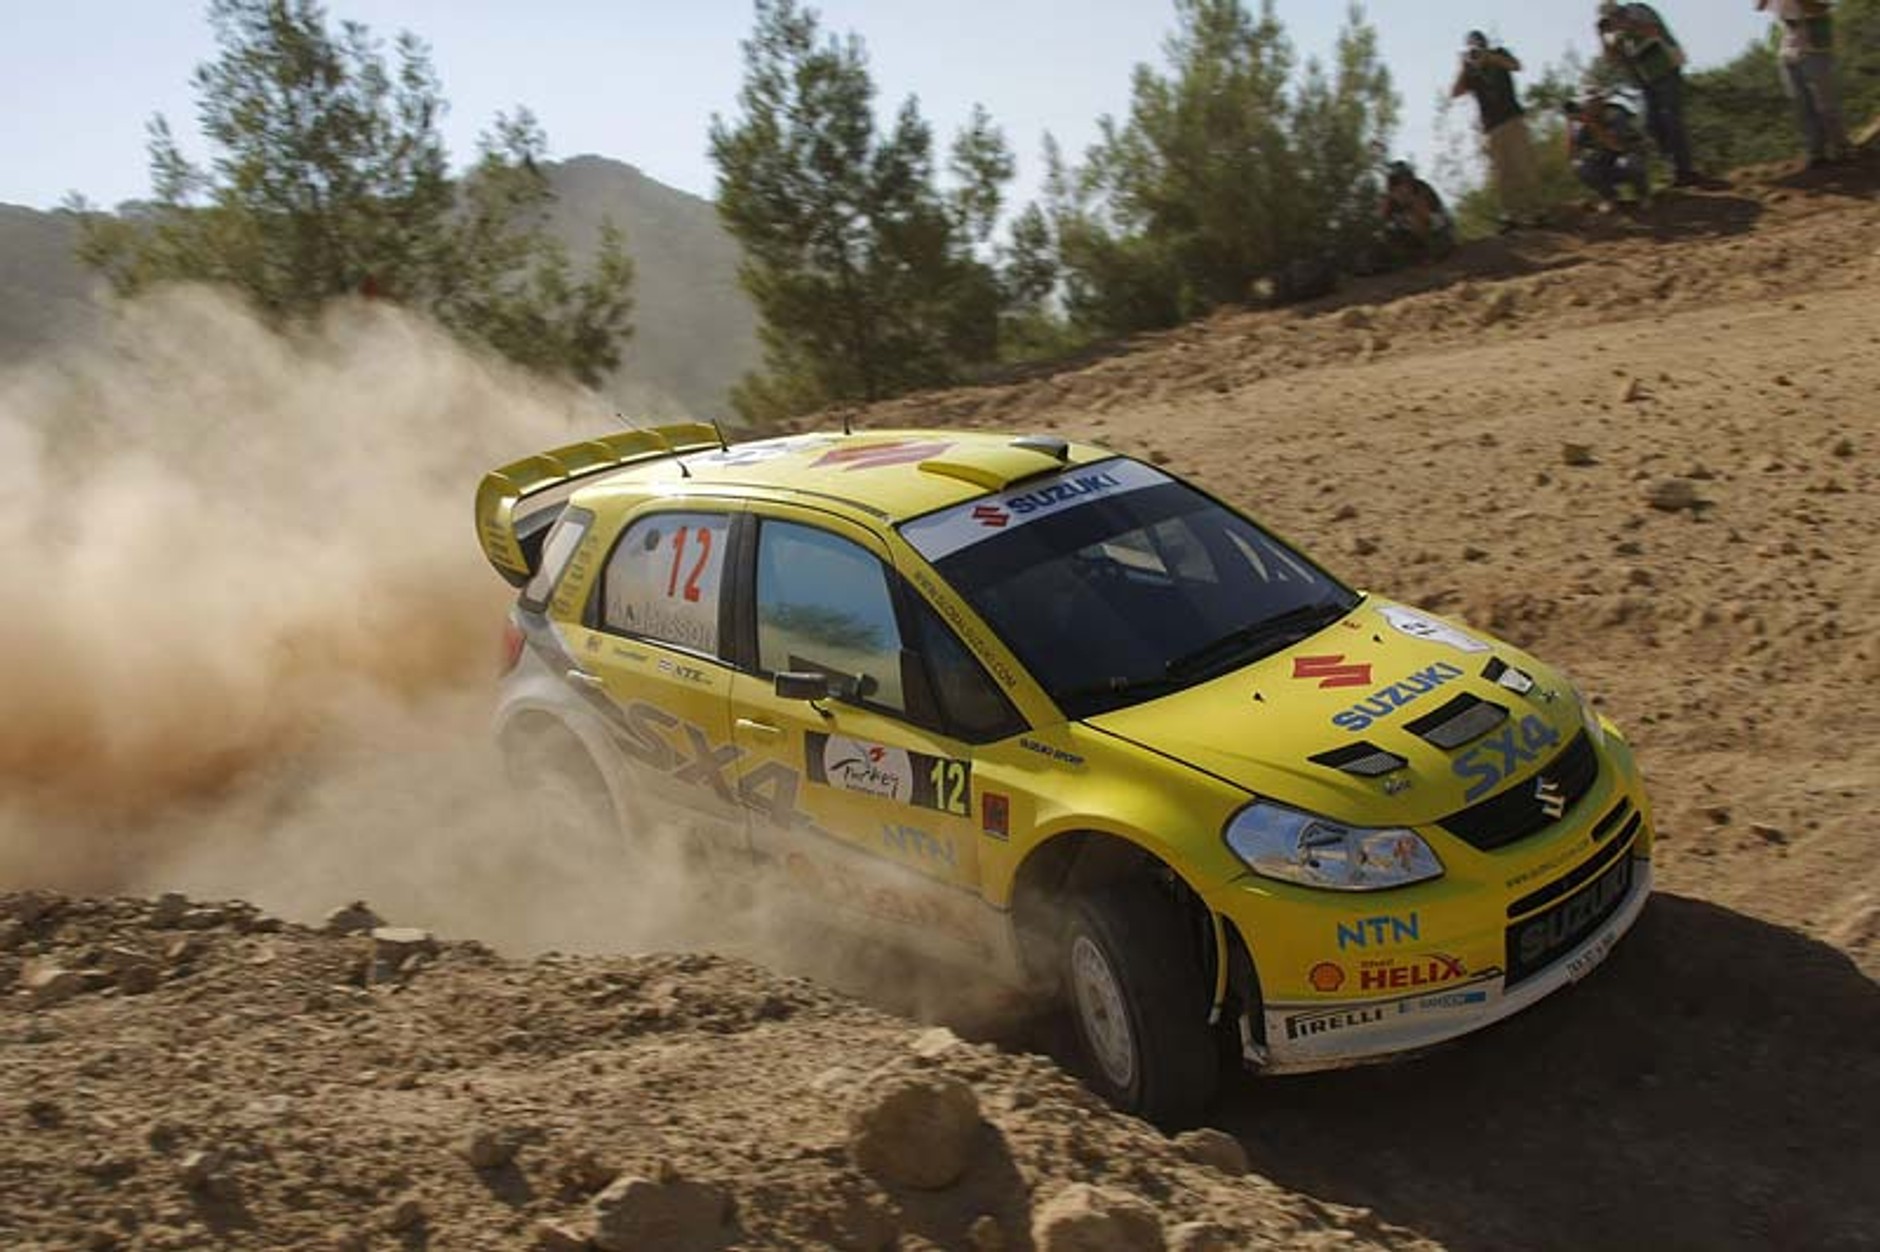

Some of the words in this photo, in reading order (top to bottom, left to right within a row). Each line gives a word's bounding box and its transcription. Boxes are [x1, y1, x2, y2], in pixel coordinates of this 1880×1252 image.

[1007, 473, 1121, 514] SUZUKI
[668, 526, 712, 602] 12
[1332, 662, 1464, 732] SUZUKI
[613, 702, 800, 832] SX4
[1453, 714, 1560, 801] SX4
[844, 766, 899, 799] Turkey
[931, 759, 965, 814] 12
[882, 823, 957, 865] NTN
[1337, 912, 1419, 951] NTN
[1520, 856, 1626, 964] SUZUKI
[1360, 954, 1467, 990] HELIX
[1285, 1009, 1382, 1040] PIRELLI
